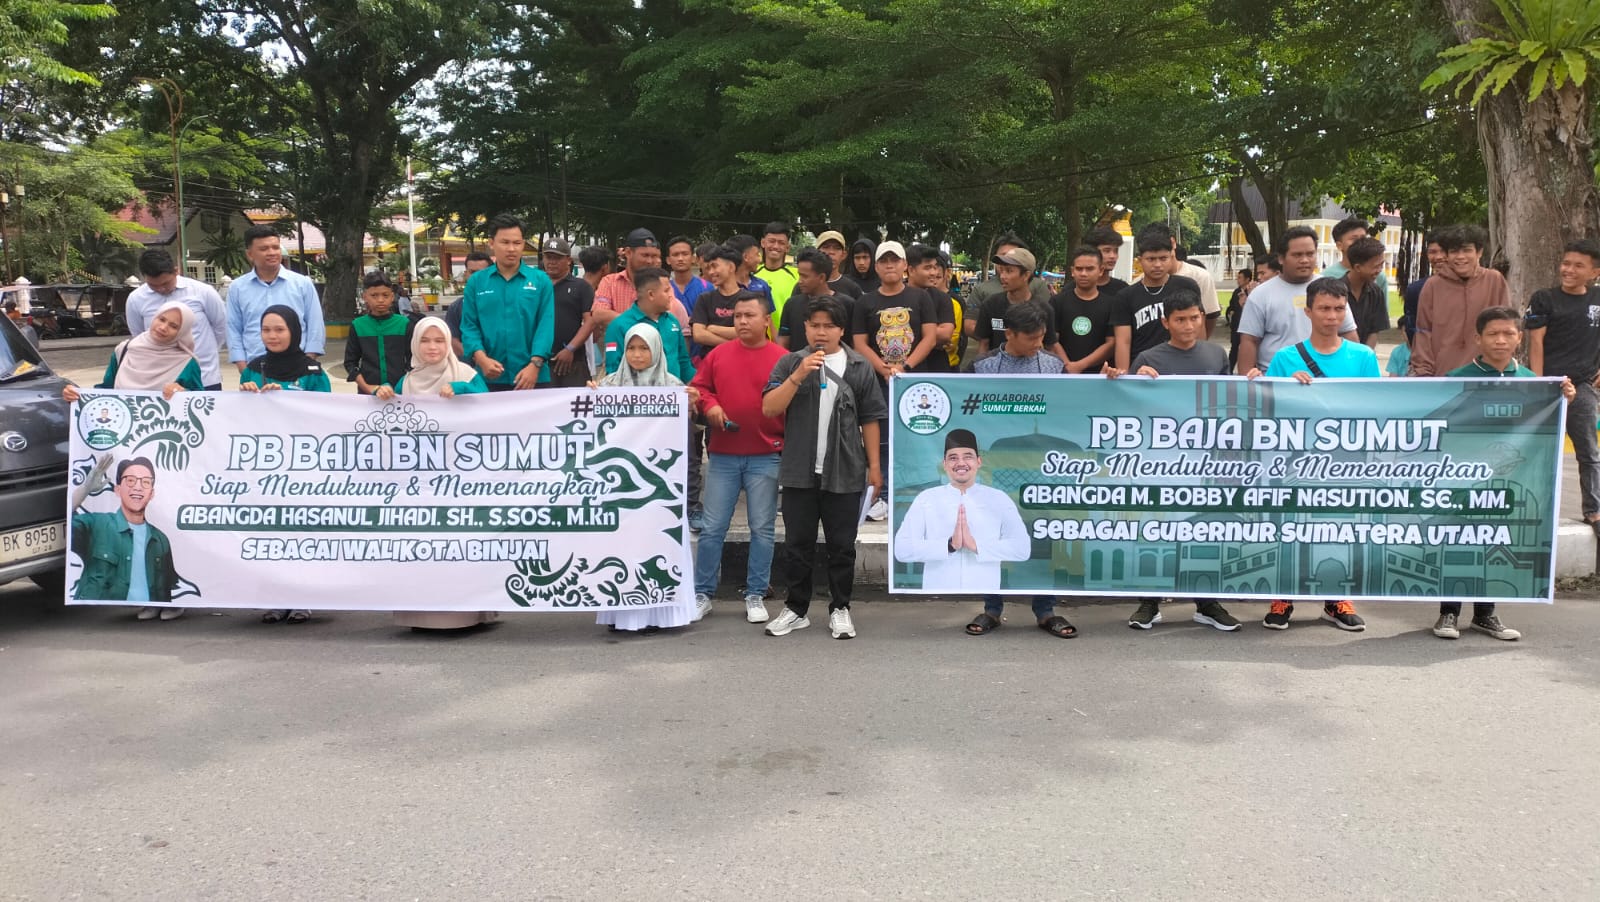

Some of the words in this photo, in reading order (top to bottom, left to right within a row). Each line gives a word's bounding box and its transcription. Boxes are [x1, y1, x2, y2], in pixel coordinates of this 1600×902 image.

[594, 405, 630, 417] BINJAI
[633, 405, 679, 415] BERKAH
[982, 404, 1013, 412] SUMUT
[1013, 405, 1046, 413] BERKAH
[1087, 416, 1143, 450] PB
[1149, 416, 1243, 450] BAJA
[1252, 418, 1308, 451] BN
[1313, 418, 1448, 451] SUMUT
[226, 433, 283, 472] PB
[288, 433, 383, 472] BAJA
[387, 433, 449, 472] BN
[454, 432, 595, 473] SUMUT
[1042, 452, 1099, 483] Siap
[1106, 453, 1263, 485] Mendukung
[1268, 456, 1286, 478] &
[1294, 454, 1493, 487] Memenangkan
[200, 474, 250, 502] Siap
[258, 474, 400, 504] Mendukung
[406, 477, 420, 496] &
[429, 473, 608, 504] Memenangkan
[1023, 485, 1126, 504] ABANGDA
[1130, 486, 1154, 505] M.
[1160, 486, 1238, 507] BOBBY
[1243, 488, 1292, 507] AFIF
[1297, 488, 1415, 508] NASUTION.
[1469, 490, 1511, 509] MM.
[180, 506, 277, 526] ABANGDA
[281, 506, 373, 527] HASANUL
[377, 507, 441, 526] JIHADI.
[446, 508, 483, 527] SH.,
[488, 507, 562, 527] S.SOS.,
[566, 507, 616, 526] M.Kn
[3, 534, 20, 552] BK
[25, 526, 57, 547] 8958
[1033, 518, 1139, 541] SEBAGAI
[1427, 525, 1512, 546] UTARA
[241, 537, 339, 561] SEBAGAI
[342, 538, 464, 562] WALIKOTA
[466, 539, 549, 562] BINJAI
